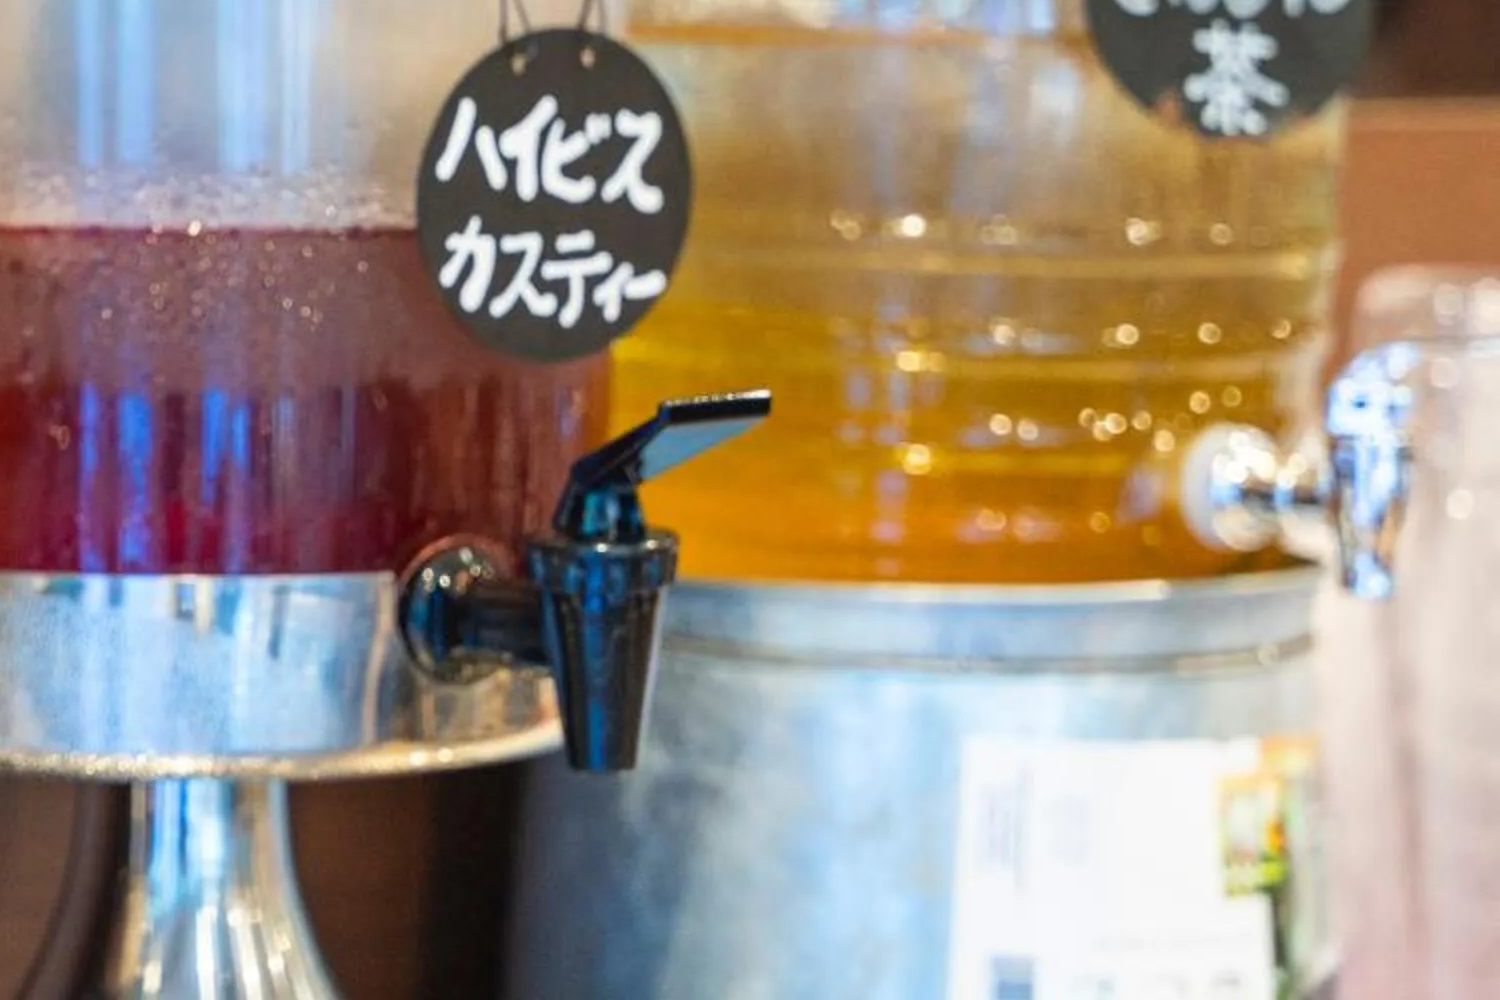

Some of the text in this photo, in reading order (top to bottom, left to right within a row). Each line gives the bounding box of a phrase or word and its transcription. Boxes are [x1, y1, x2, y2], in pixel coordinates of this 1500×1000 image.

[1184, 17, 1289, 136] 茶
[435, 95, 664, 213] ハイビス
[439, 215, 667, 328] カスティー
